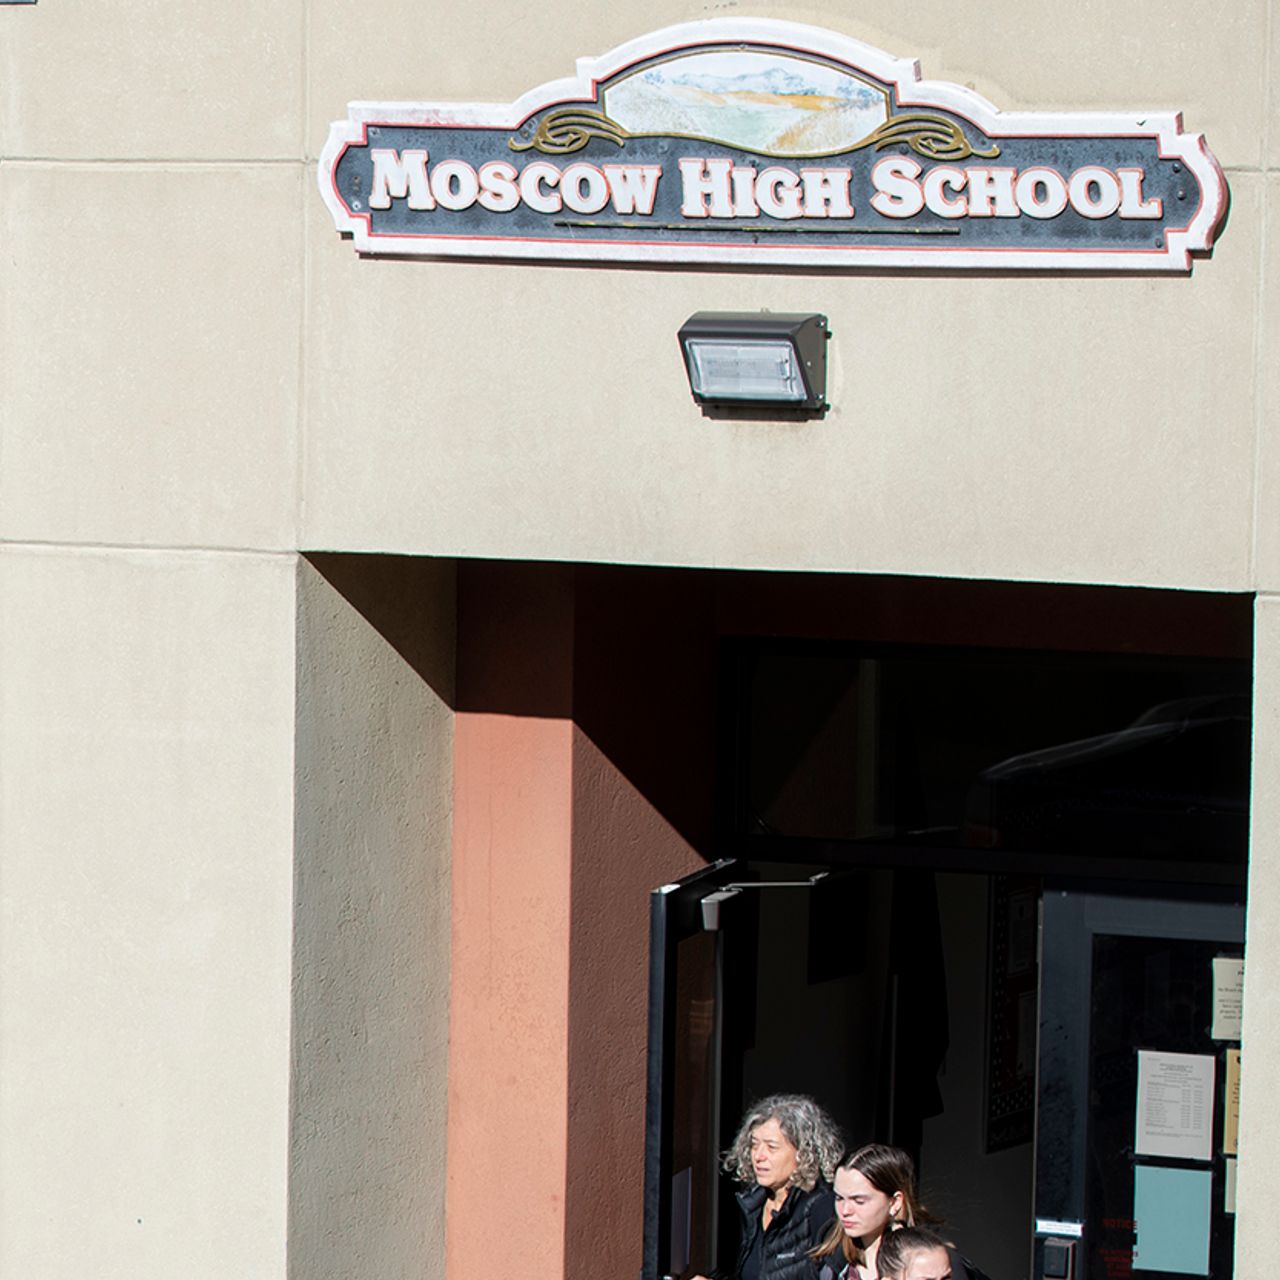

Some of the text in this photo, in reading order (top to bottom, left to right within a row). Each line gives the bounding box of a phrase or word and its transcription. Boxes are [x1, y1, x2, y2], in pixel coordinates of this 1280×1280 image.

[370, 149, 1164, 221] MOSCOW HIGH SCHOOL
